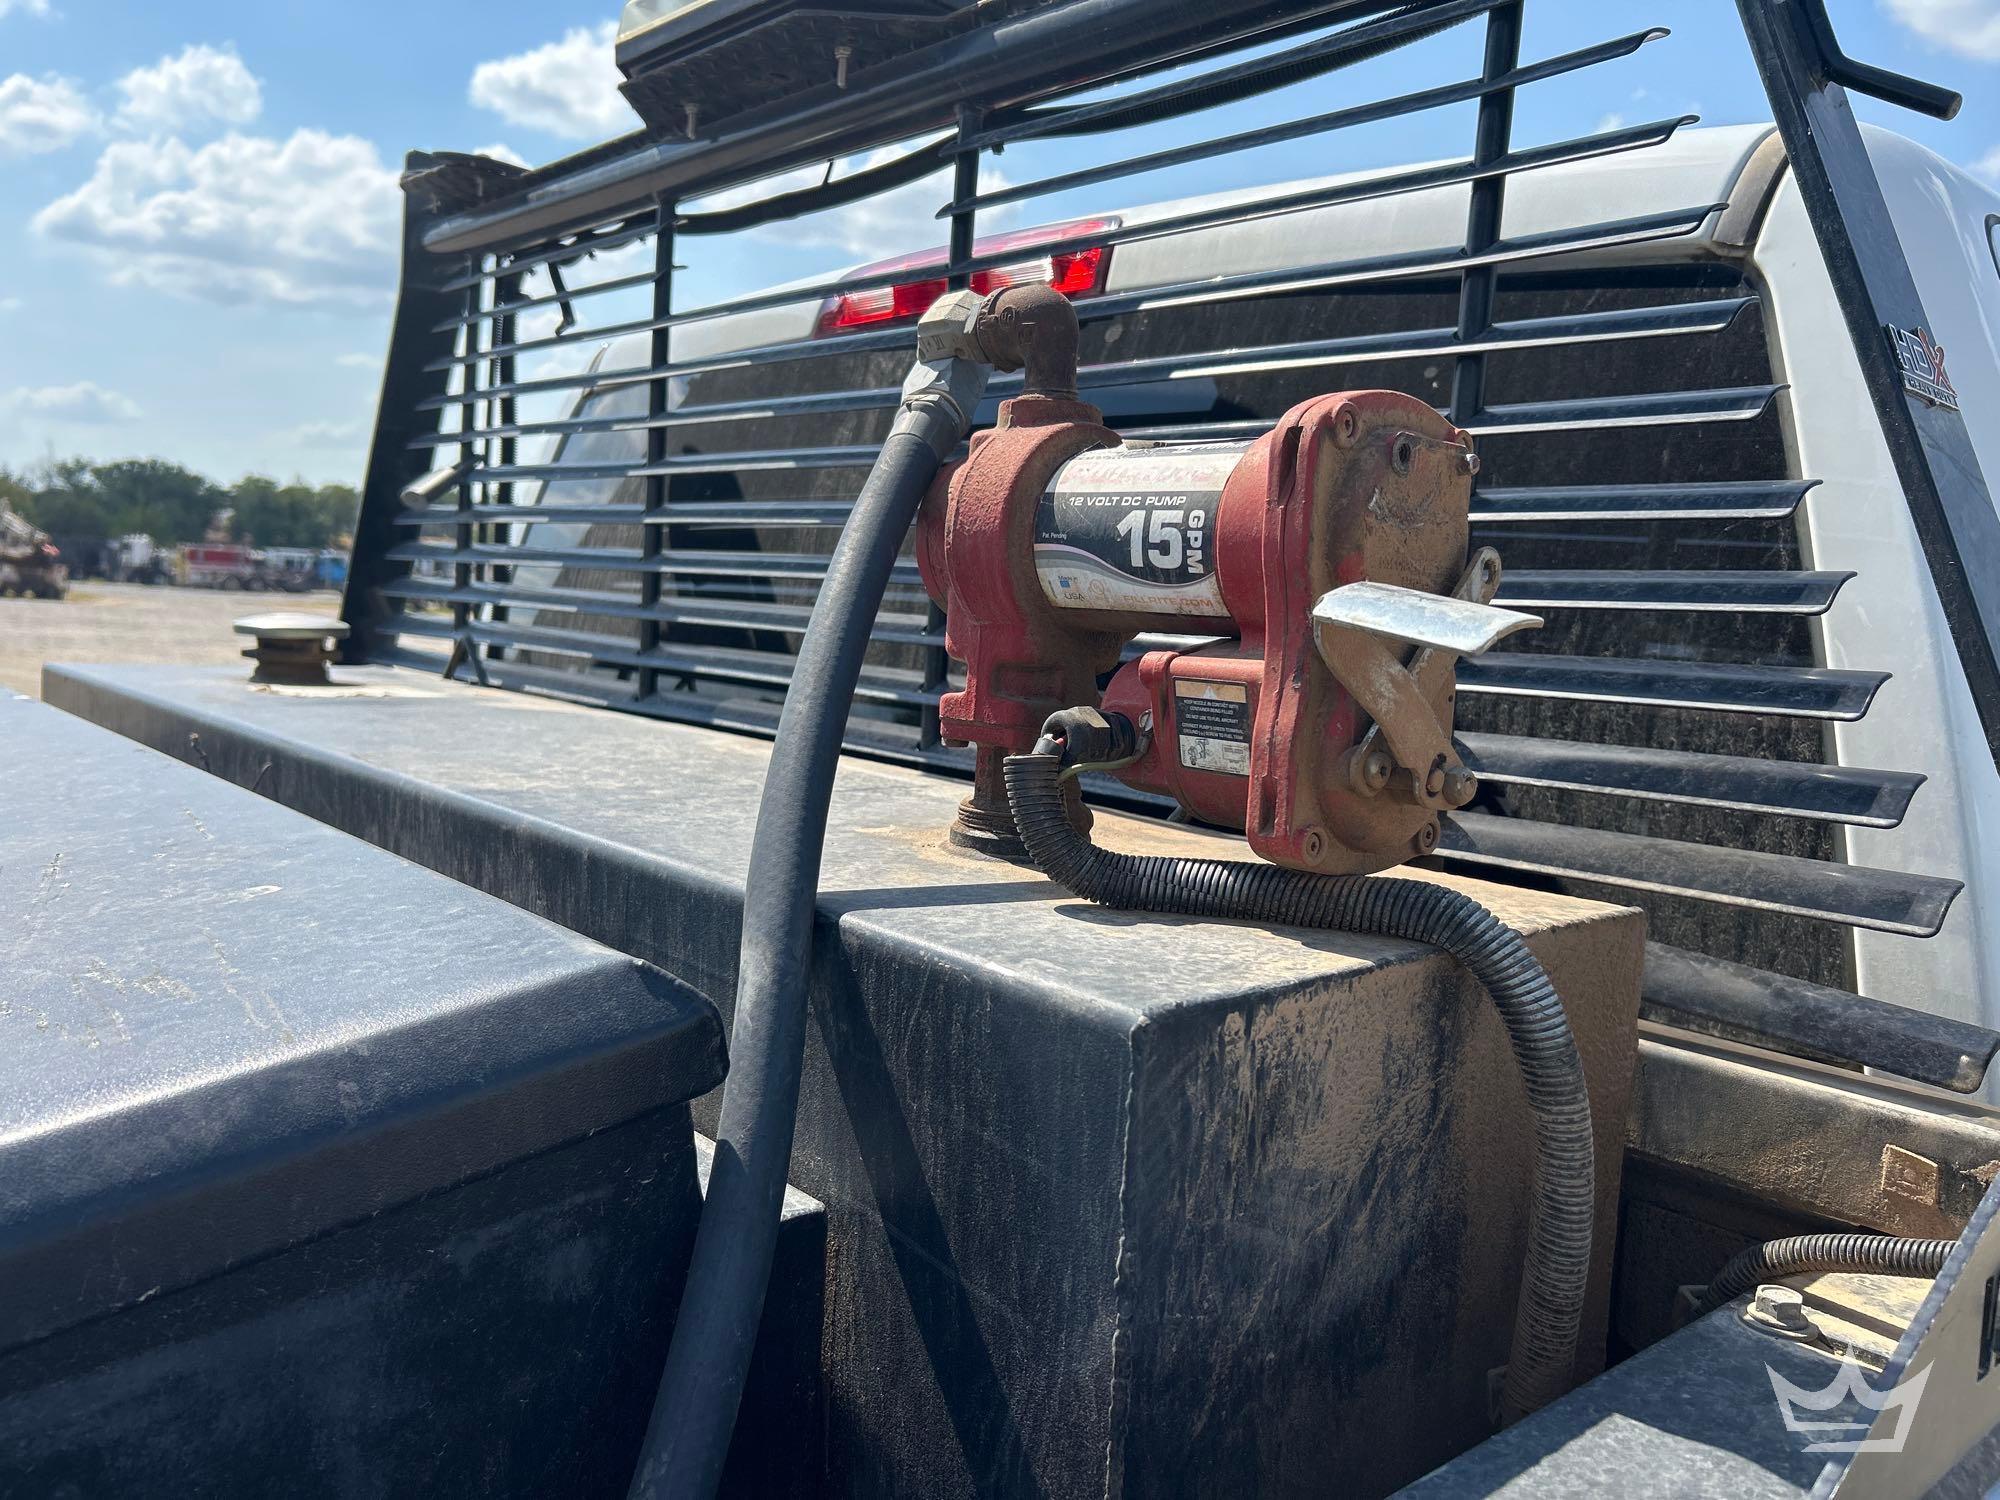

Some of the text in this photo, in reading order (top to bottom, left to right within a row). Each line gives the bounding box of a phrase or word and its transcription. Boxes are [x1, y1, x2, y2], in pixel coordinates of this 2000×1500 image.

[1068, 495, 1187, 506] 12 VOLT DC PUMP
[1116, 509, 1185, 570] 15
[1186, 509, 1206, 574] GPM
[1064, 592, 1086, 602] USA
